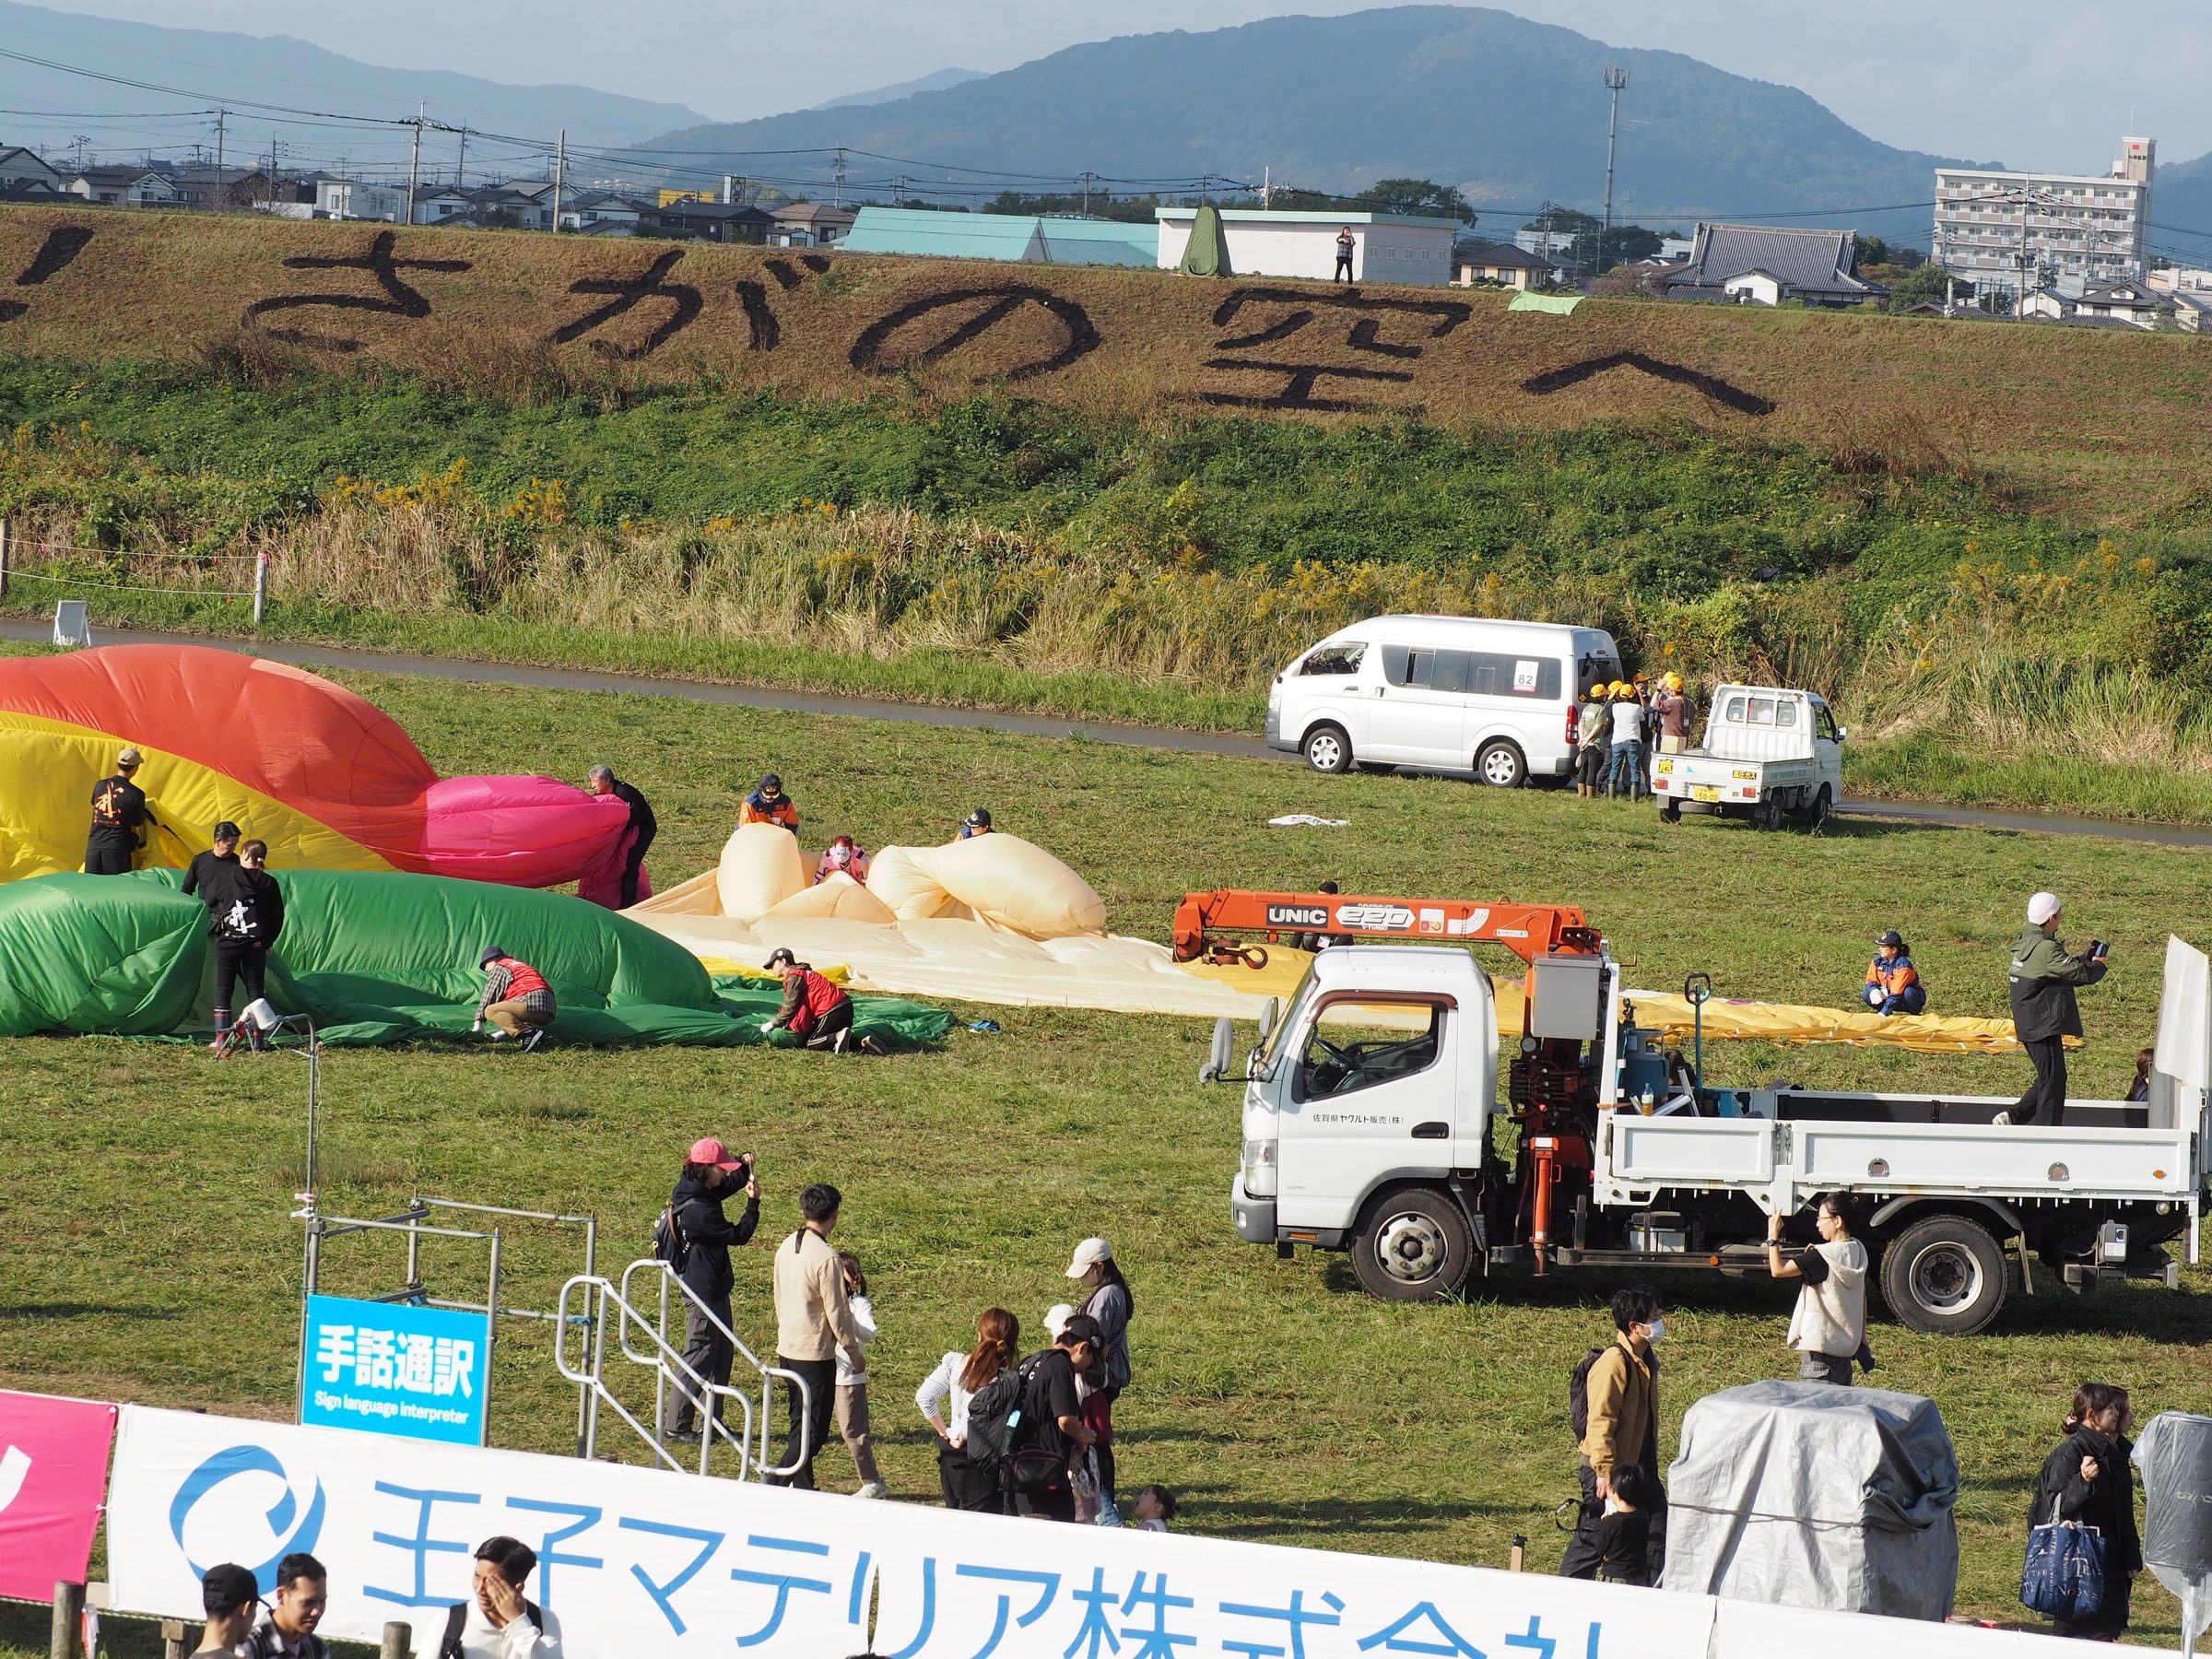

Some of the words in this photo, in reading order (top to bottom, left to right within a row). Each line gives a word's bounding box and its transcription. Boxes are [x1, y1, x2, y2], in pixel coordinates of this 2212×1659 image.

[1518, 674, 1533, 685] 82
[1268, 907, 1327, 924] UNIC
[1341, 907, 1410, 925] 220
[315, 1324, 475, 1400] 手話通訳
[314, 1390, 342, 1412] Sign
[344, 1394, 398, 1418] language
[400, 1401, 469, 1425] interpreter
